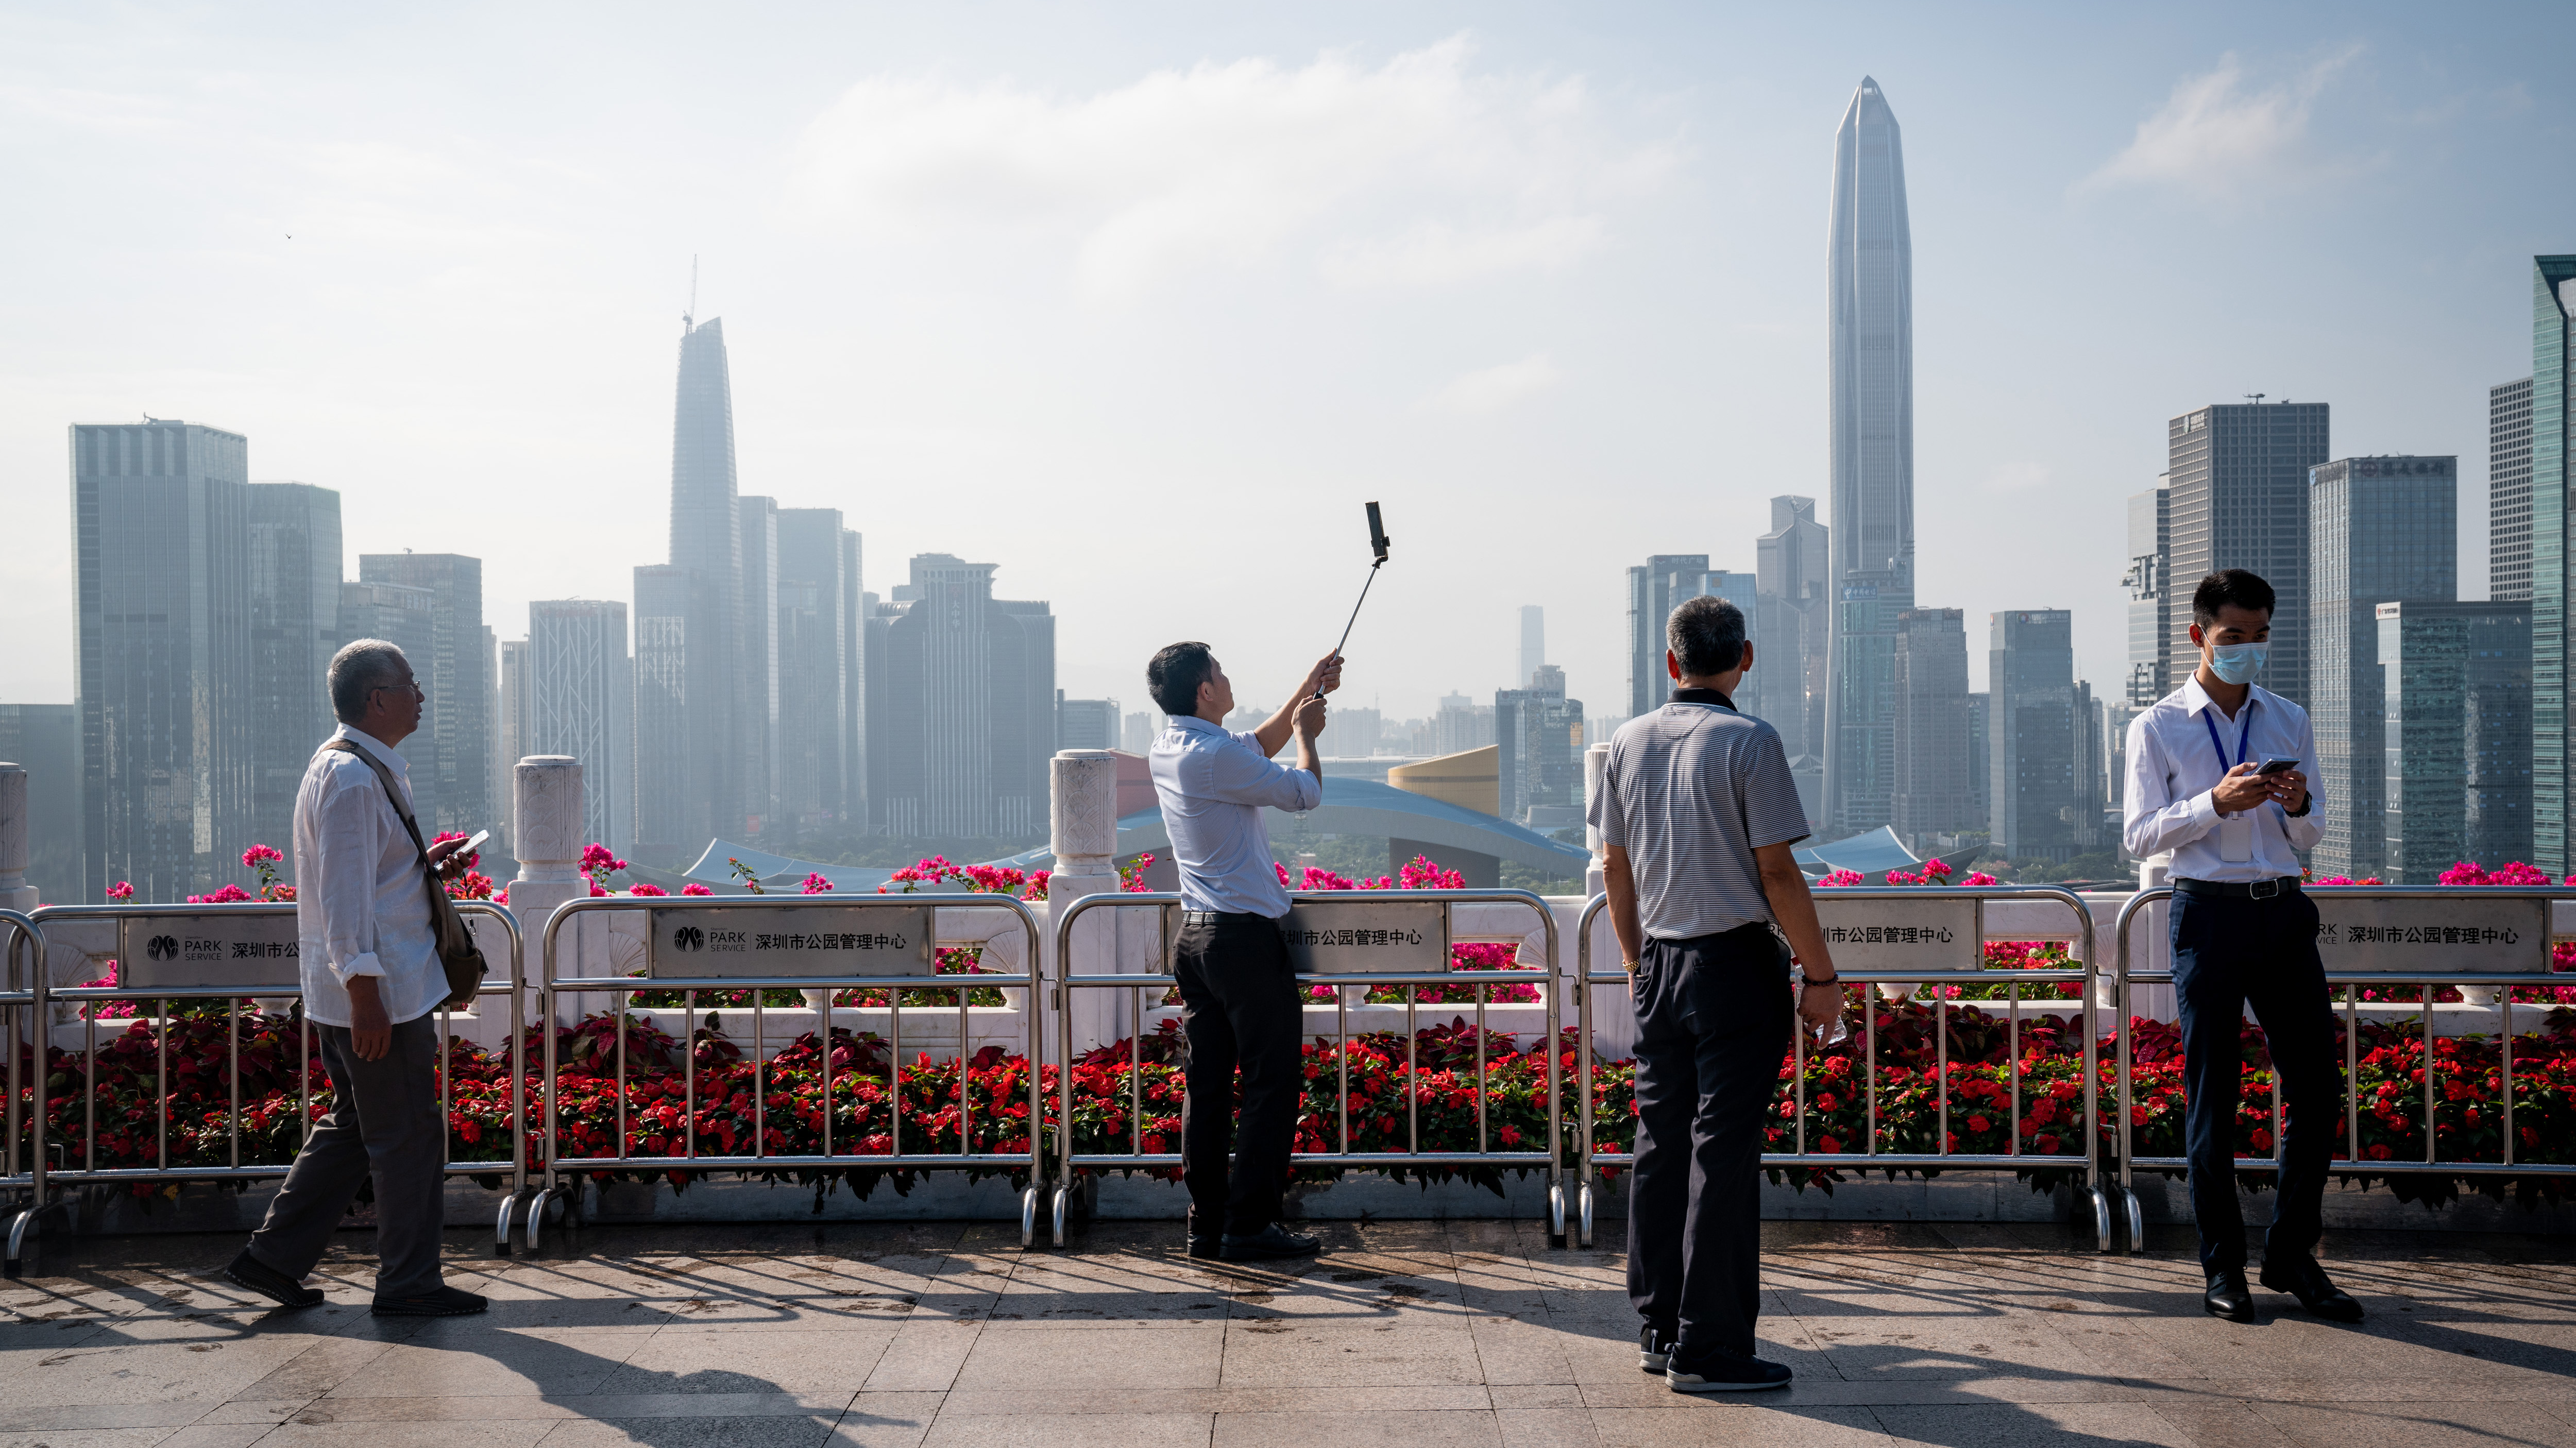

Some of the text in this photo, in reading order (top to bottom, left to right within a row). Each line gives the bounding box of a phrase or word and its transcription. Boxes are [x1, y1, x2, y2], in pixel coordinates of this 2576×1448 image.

[1671, 556, 1704, 565] 时代广场
[951, 600, 960, 628] 大中华
[1770, 925, 1785, 935] RK
[1821, 926, 1954, 944] 市公园管理中心
[2319, 924, 2337, 935] RK
[2348, 926, 2519, 944] 深圳市公园管理中心
[710, 932, 746, 943] PARK
[755, 933, 907, 950] 深圳市公园管理中心
[185, 940, 222, 952] PARK
